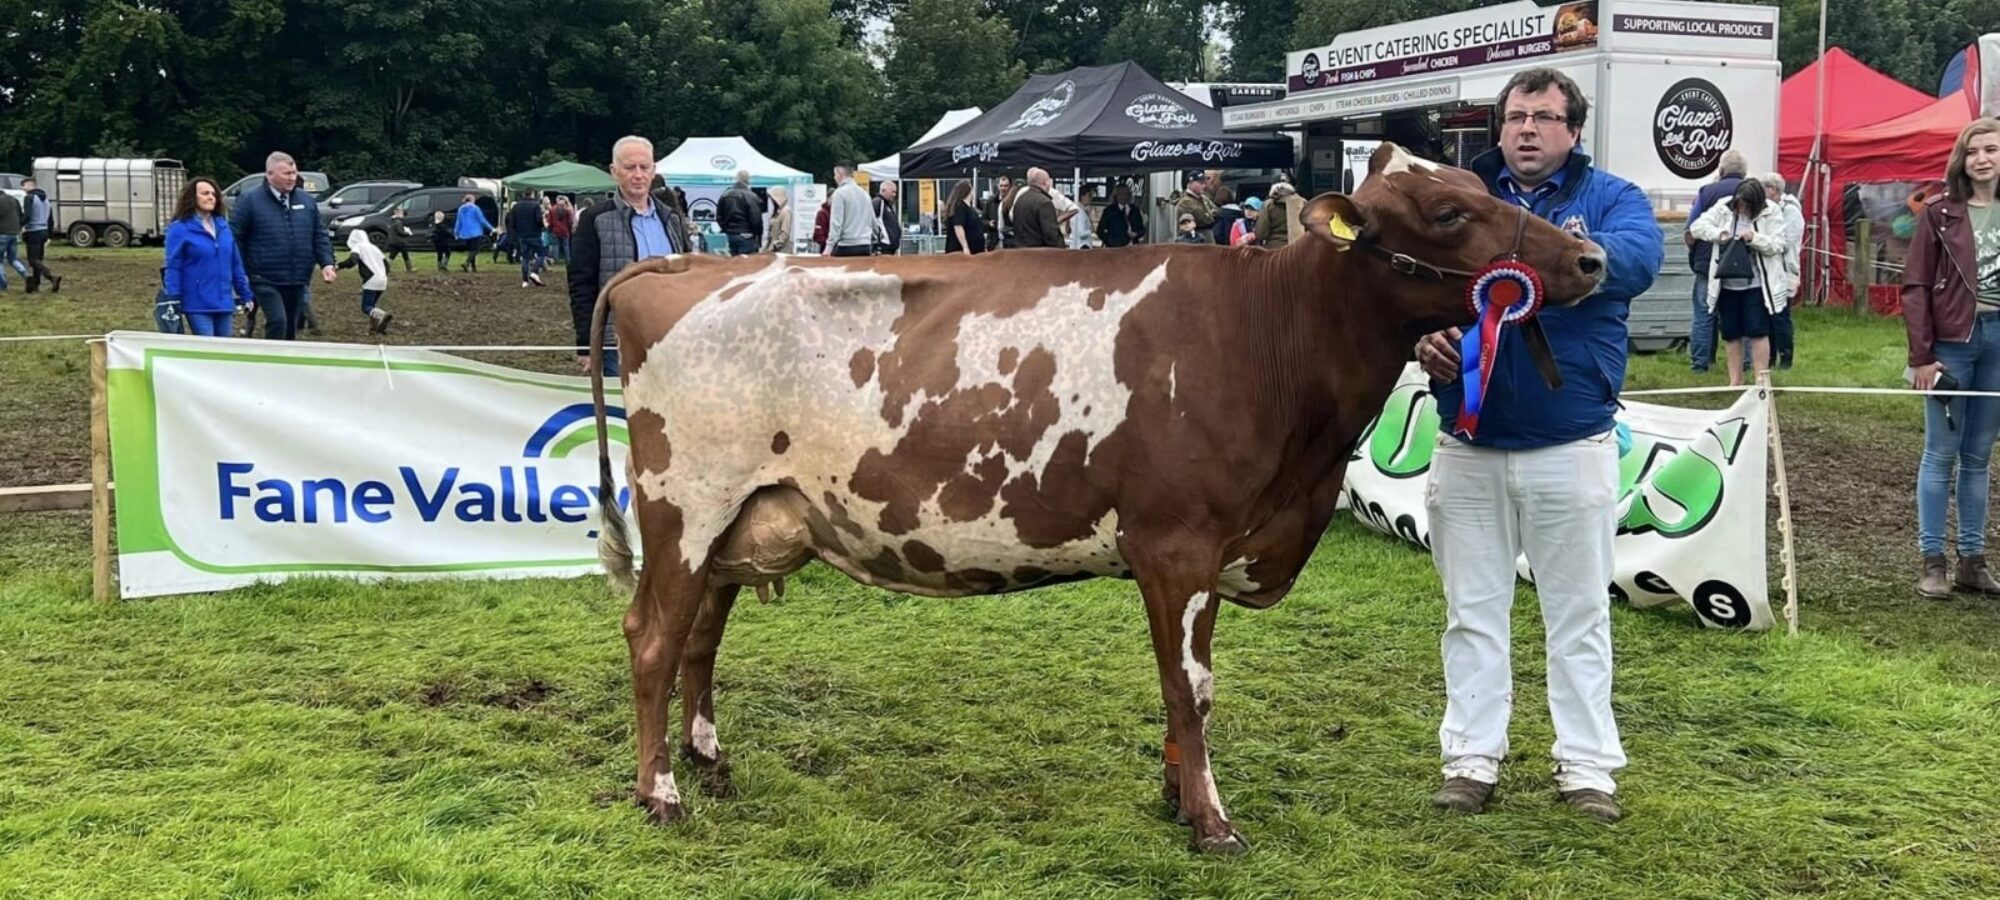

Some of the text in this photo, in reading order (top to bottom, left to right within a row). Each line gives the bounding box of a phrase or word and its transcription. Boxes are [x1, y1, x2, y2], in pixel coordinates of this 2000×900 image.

[1623, 18, 1764, 36] SUPPORTING LOCAL PRODUCE
[1328, 15, 1546, 67] EVENT CATERING SPECIALIST
[1517, 41, 1551, 55] BURGERS
[1430, 55, 1459, 69] CHICKEN
[1359, 68, 1377, 80] CHIPS
[1374, 92, 1400, 104] BURGERS
[1403, 88, 1428, 100] CHILLED
[1428, 85, 1452, 97] DRINKS
[1125, 102, 1178, 117] Glaze
[1159, 112, 1198, 124] Roll
[1657, 104, 1717, 131] Glaze
[1683, 128, 1729, 155] Roll
[1131, 140, 1183, 161] Glaze
[1202, 140, 1243, 162] Roll
[216, 461, 394, 524] Fane
